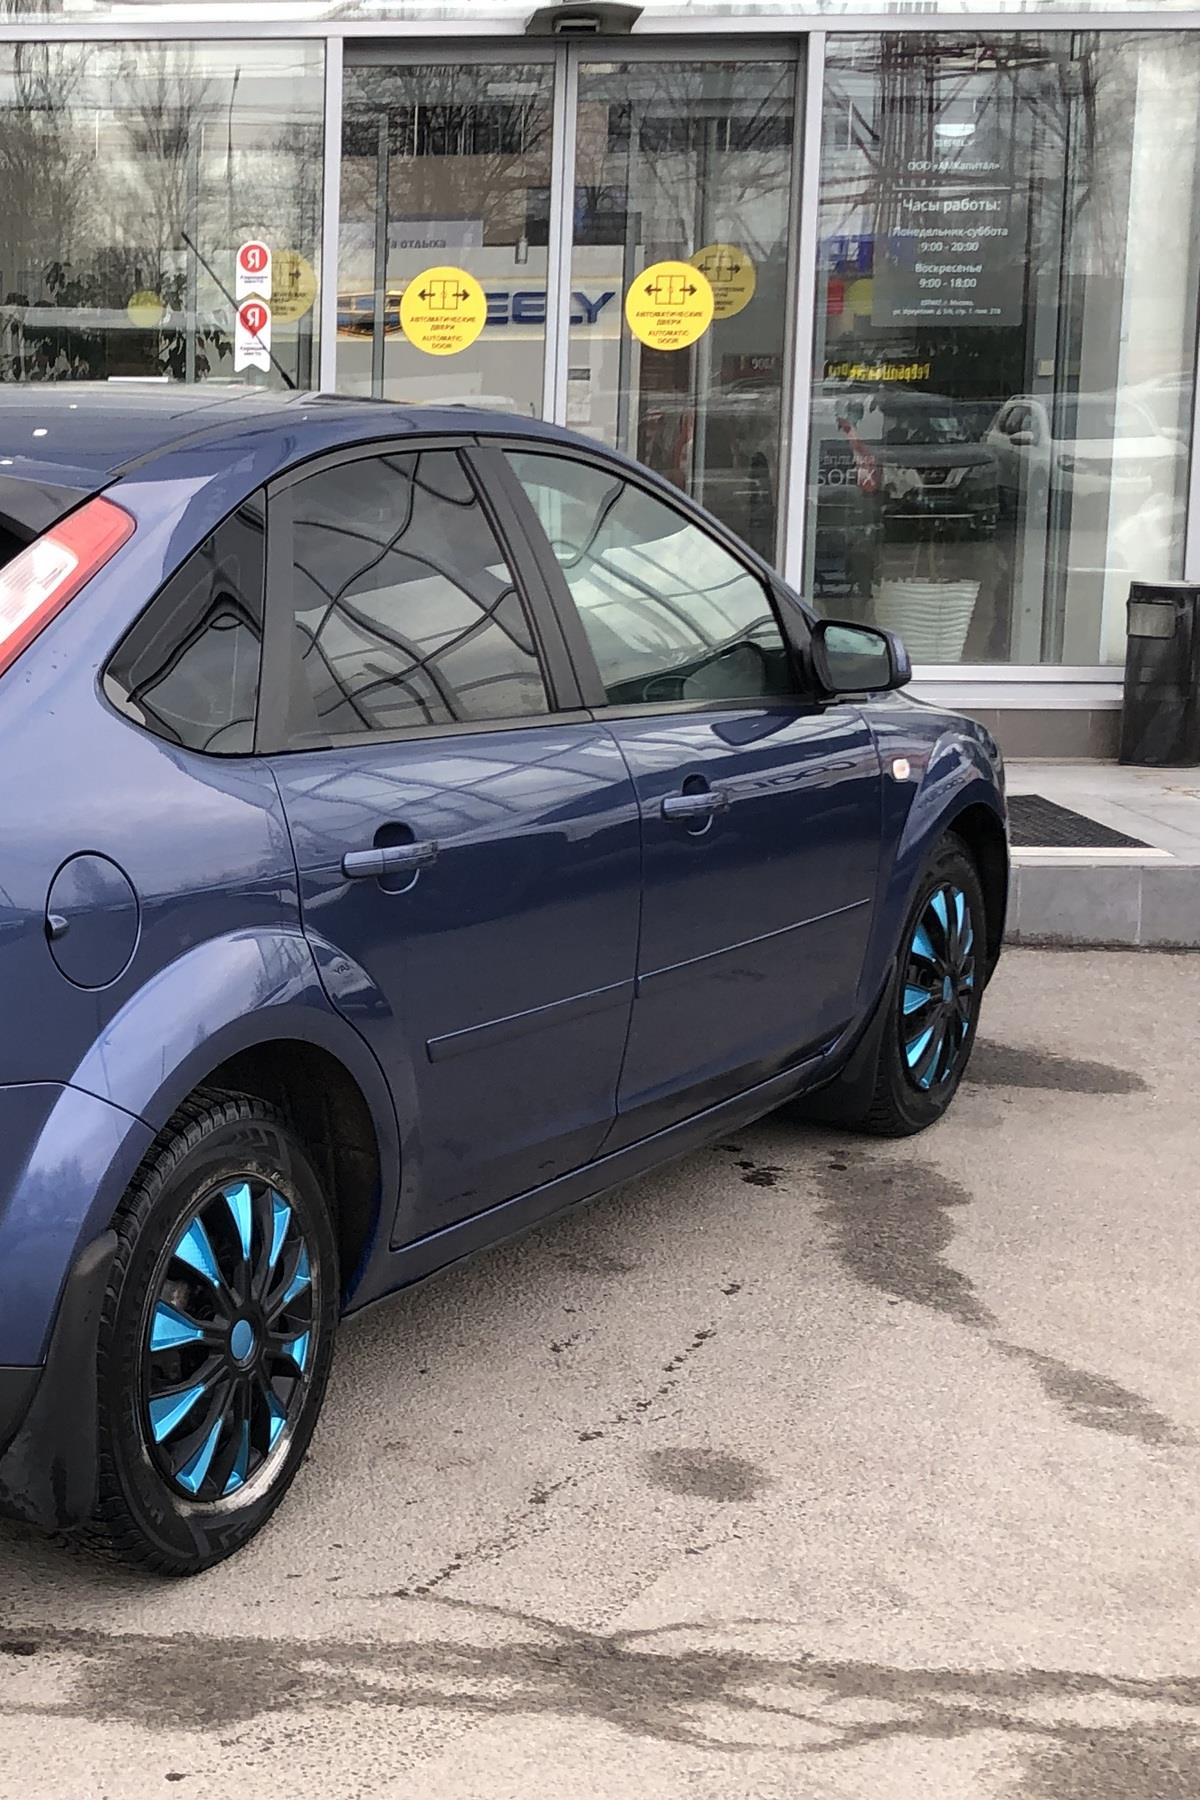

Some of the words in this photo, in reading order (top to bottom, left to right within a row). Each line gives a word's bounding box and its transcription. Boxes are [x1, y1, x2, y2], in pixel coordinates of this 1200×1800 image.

[903, 199, 940, 211] Часы
[943, 198, 1001, 214] работы:
[920, 241, 943, 252] 9:00
[951, 241, 979, 252] 20:00
[915, 263, 983, 274] Воскресенье
[919, 278, 941, 288] 9:00
[950, 278, 977, 288] 18:00
